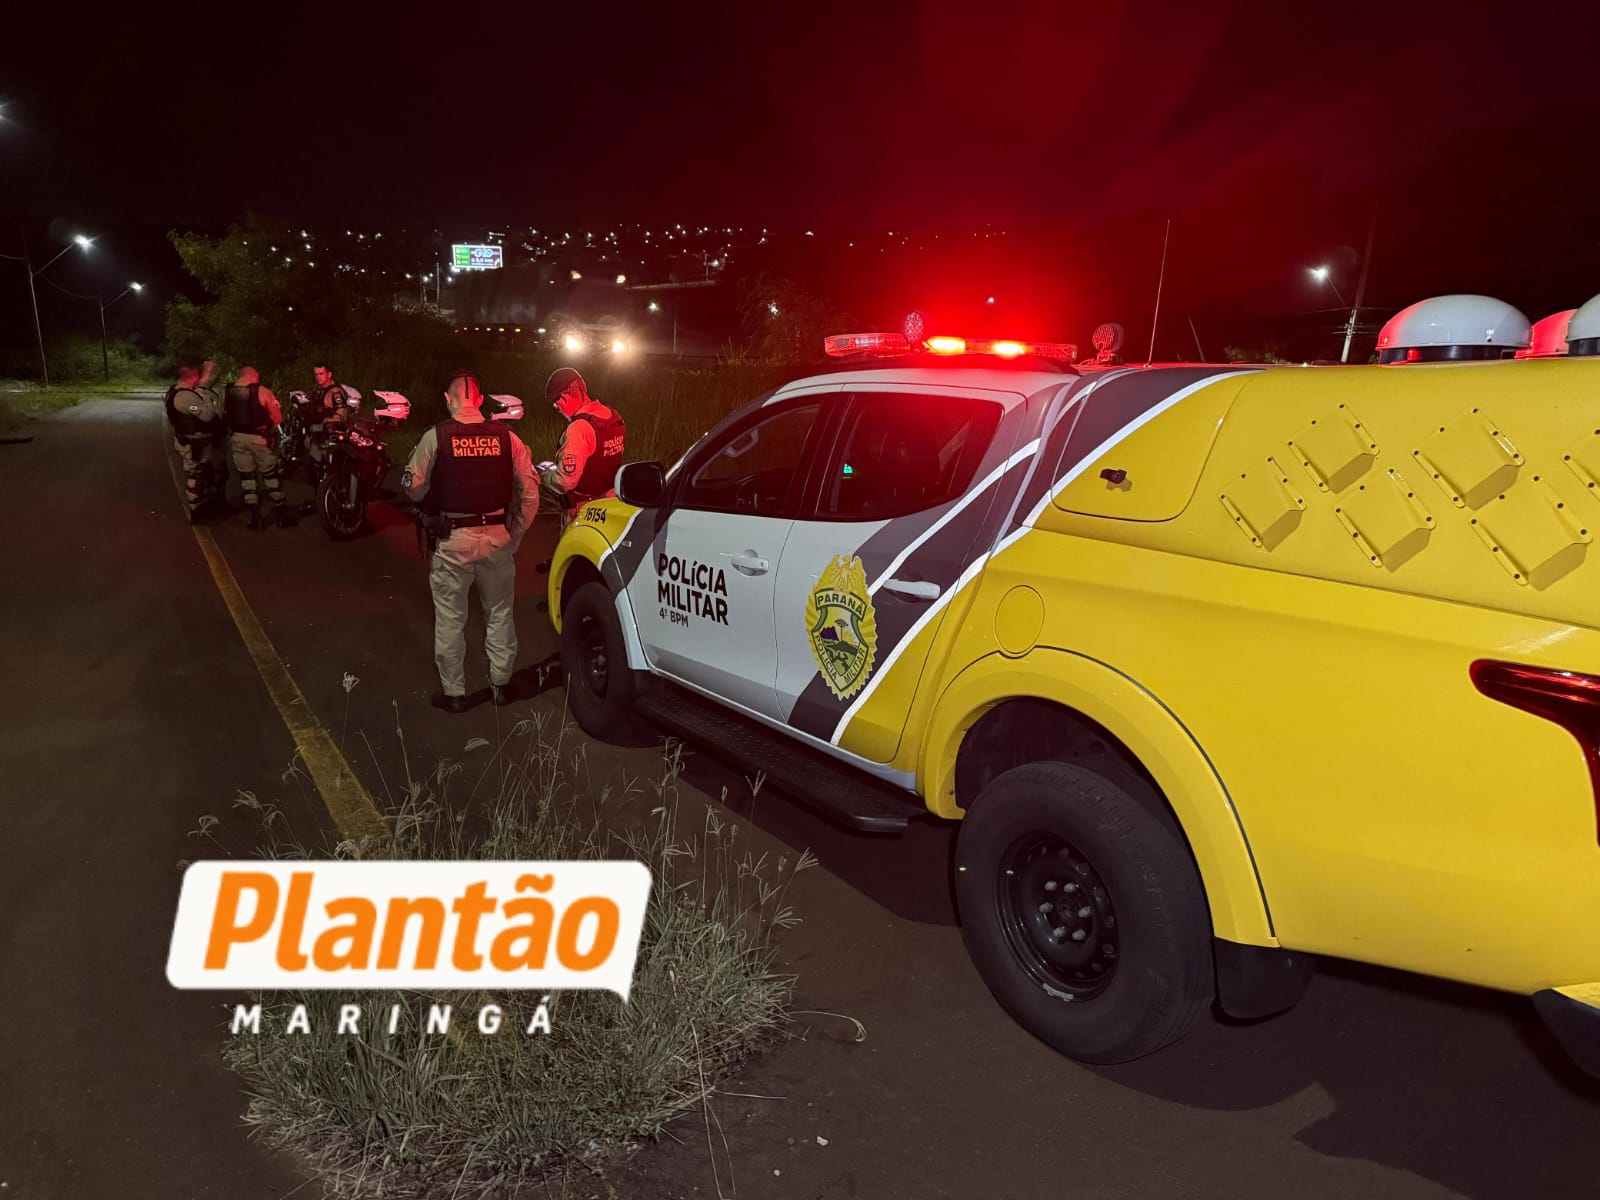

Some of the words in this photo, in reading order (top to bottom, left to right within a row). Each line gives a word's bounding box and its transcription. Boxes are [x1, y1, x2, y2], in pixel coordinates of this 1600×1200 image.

[452, 436, 500, 447] POLÍCIA
[454, 447, 501, 457] MILITAR
[583, 507, 607, 524] 16154
[658, 553, 728, 596] POLÍCIA
[658, 579, 729, 625] MILITAR
[817, 593, 863, 615] PARANÁ
[670, 610, 689, 628] BPM
[843, 647, 866, 684] MILITAR
